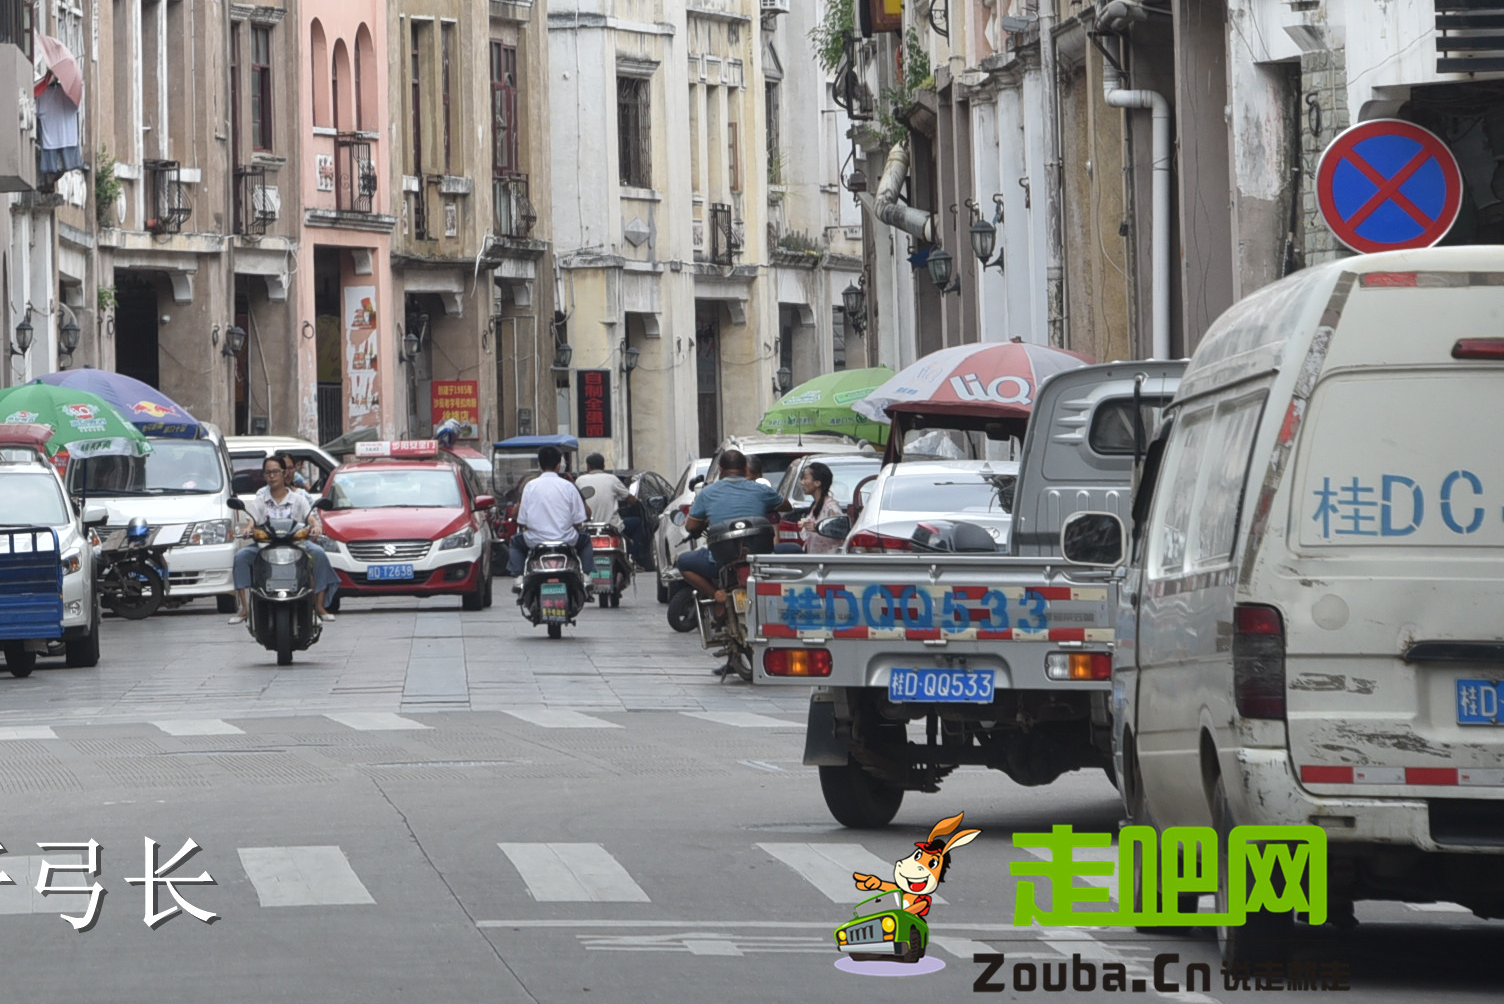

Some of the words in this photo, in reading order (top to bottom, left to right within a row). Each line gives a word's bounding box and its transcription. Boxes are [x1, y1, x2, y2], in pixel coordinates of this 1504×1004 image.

[585, 372, 604, 437] 自制全蛋面
[783, 583, 1049, 634] 桂DQQ533
